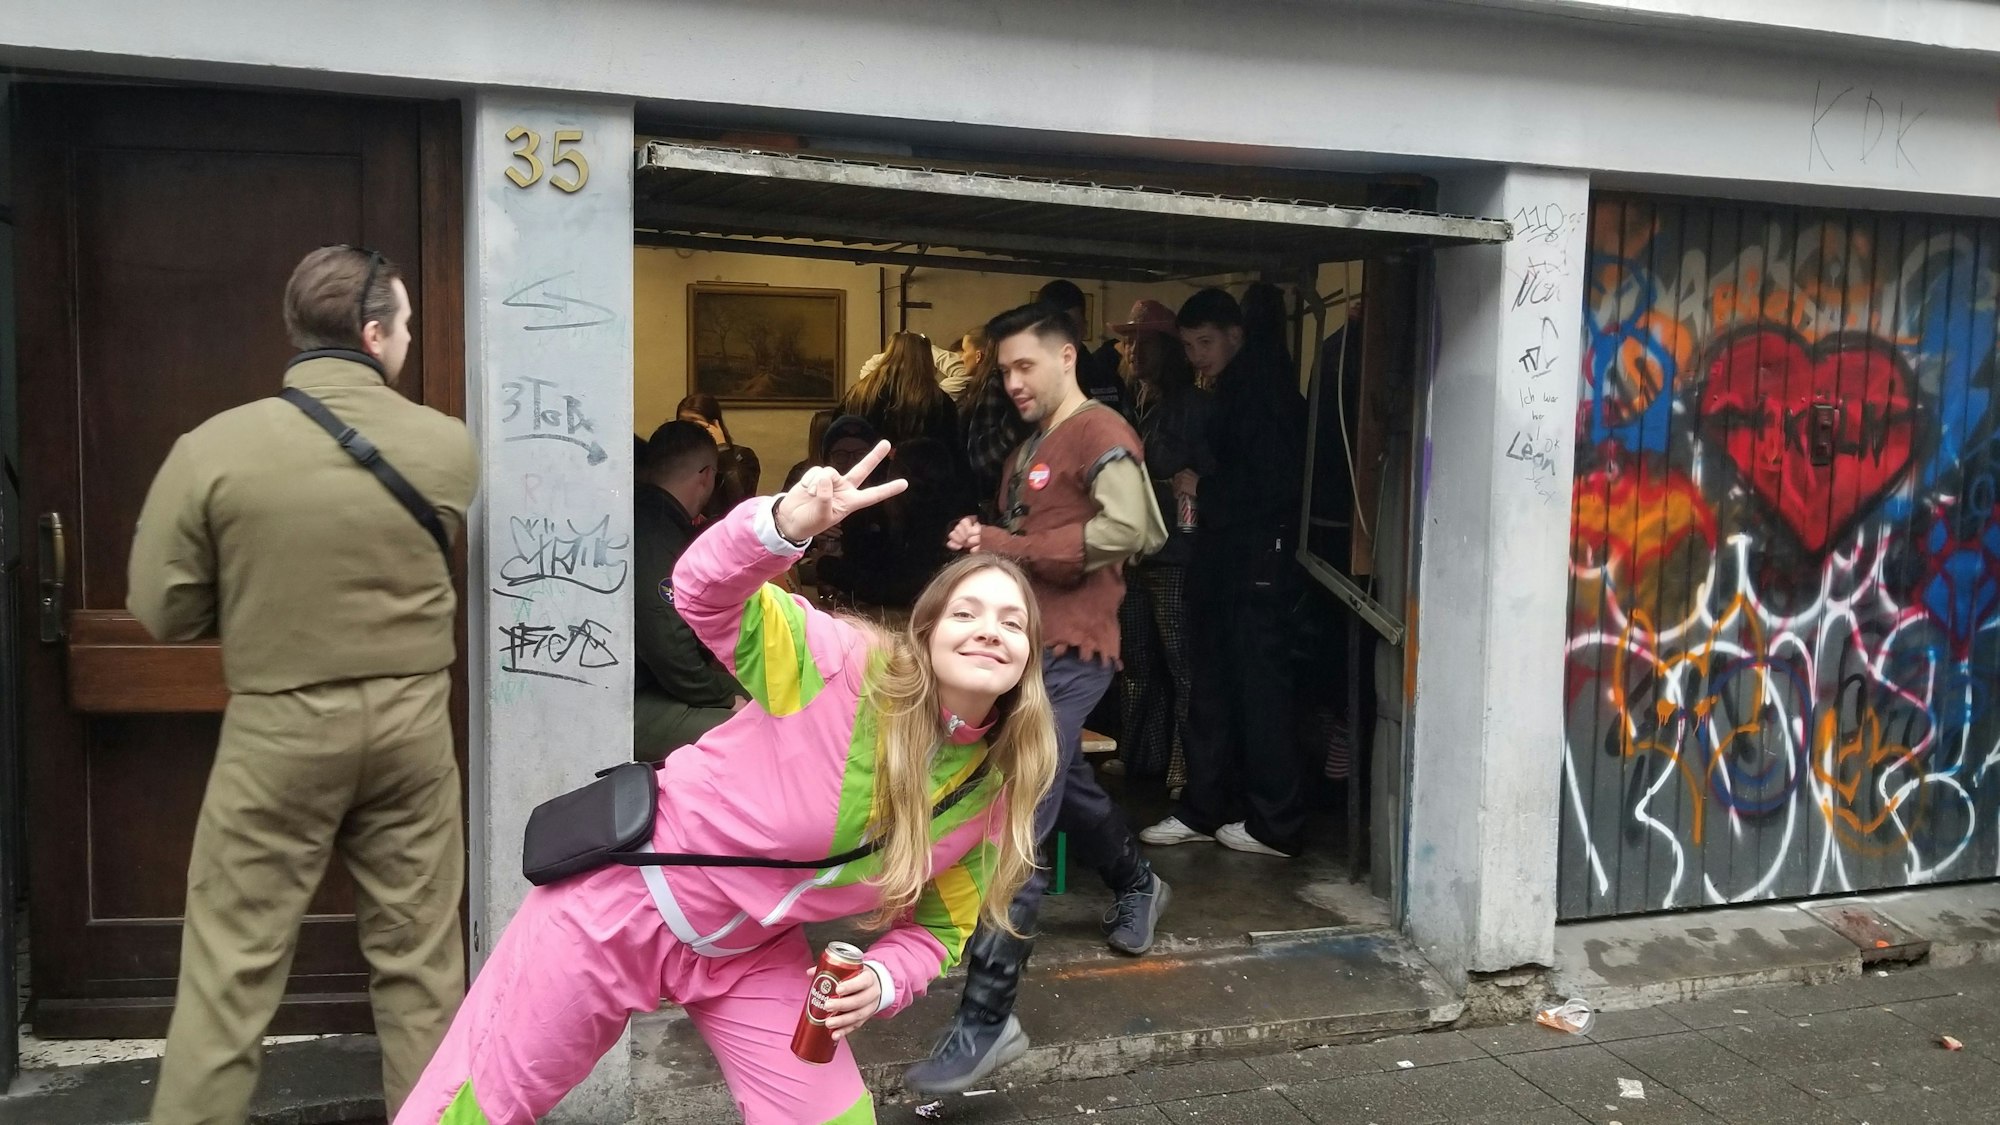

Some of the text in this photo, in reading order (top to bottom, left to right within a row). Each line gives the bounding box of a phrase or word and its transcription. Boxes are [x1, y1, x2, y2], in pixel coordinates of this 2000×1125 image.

[504, 125, 589, 193] 35
[1808, 80, 1929, 177] KDK
[1519, 386, 1535, 409] Ich
